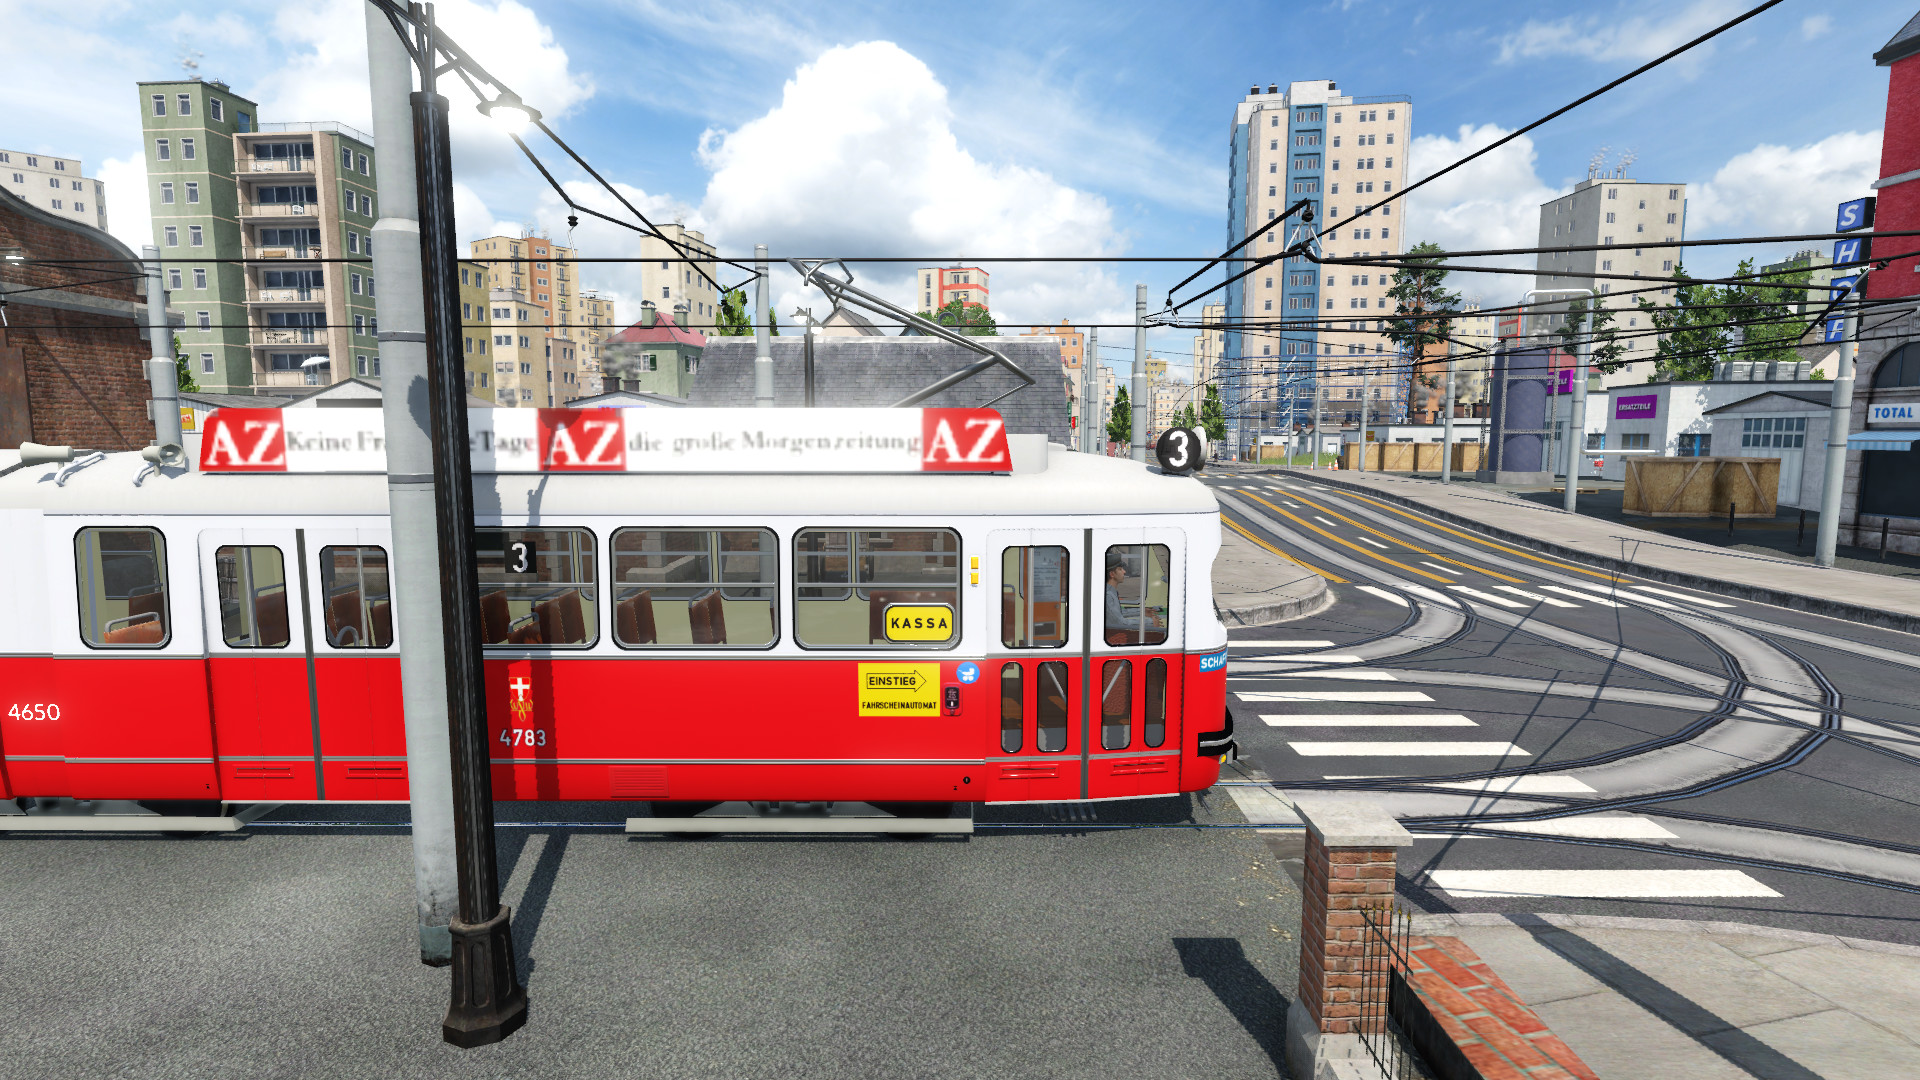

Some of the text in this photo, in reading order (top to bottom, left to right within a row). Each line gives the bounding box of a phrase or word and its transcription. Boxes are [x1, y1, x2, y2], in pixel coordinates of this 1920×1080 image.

[1874, 407, 1913, 419] TOTAL
[204, 420, 285, 466] AZ
[285, 430, 352, 452] Keine
[357, 430, 386, 452] Fr
[476, 430, 536, 457] Tage
[544, 419, 622, 466] AZ
[629, 431, 662, 452] die
[672, 431, 736, 457] große
[742, 430, 923, 458] Morgenzeitung
[923, 417, 1005, 463] AZ
[1169, 430, 1189, 467] 3
[511, 542, 528, 573] 3
[891, 618, 948, 629] KASSA
[868, 676, 916, 686] EINSTIEG
[8, 703, 61, 721] 4650
[862, 701, 937, 710] FAHRSCHEINAUTOMAT
[500, 728, 547, 747] 4783
